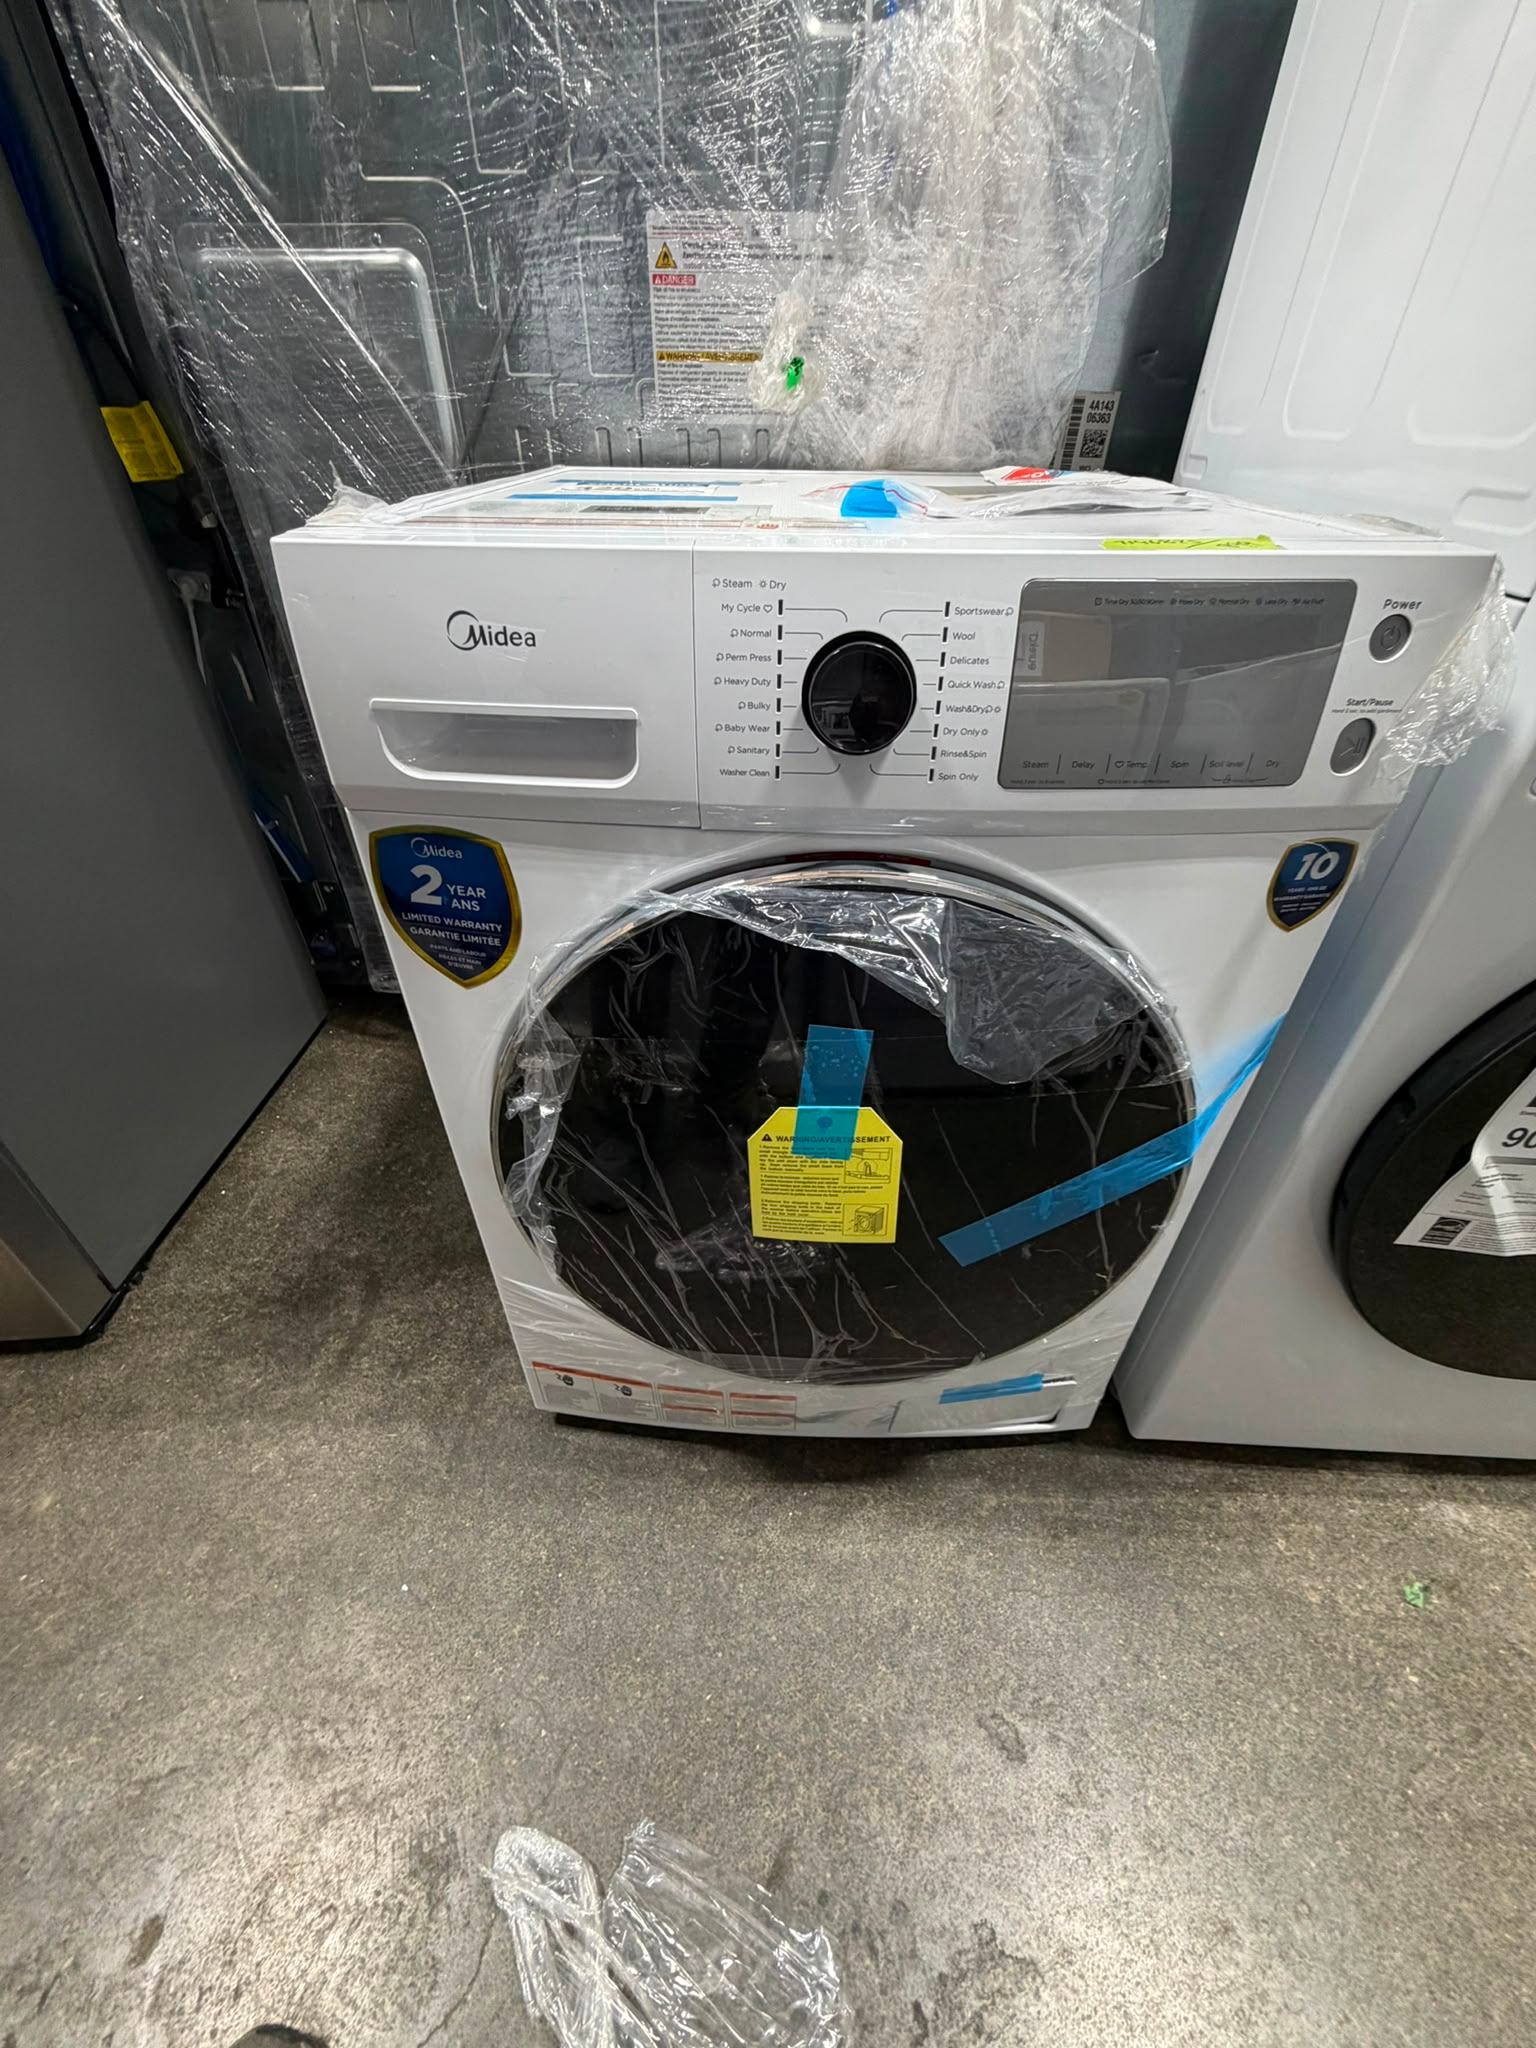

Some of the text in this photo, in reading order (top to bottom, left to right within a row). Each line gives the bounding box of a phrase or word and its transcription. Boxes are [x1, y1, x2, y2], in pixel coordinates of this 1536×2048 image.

[662, 274, 694, 286] DANGER
[1089, 400, 1115, 411] 4A143
[722, 578, 787, 591] Steam Dry
[721, 603, 761, 613] My Cycle
[1382, 599, 1423, 610] Power
[954, 606, 1005, 616] Sportswear
[450, 613, 537, 649] Midea
[740, 629, 772, 638] Normal
[952, 631, 976, 640] Wool
[725, 653, 772, 662] Perm Press
[950, 656, 990, 665] Delicates
[724, 677, 771, 687] Heavy Duty
[947, 680, 996, 689] Quick Wash
[747, 701, 771, 711] Bulky
[1346, 698, 1394, 707] Start/Pause
[945, 704, 985, 714] Wash&Dry
[724, 724, 770, 733] Baby Wear
[943, 727, 980, 737] Dry Only
[736, 746, 770, 755] Sanitary
[940, 750, 987, 758] Rinse&Spin
[1022, 760, 1049, 768] Steam
[1072, 760, 1095, 770] Delay
[1170, 760, 1189, 770] Spin
[1209, 760, 1224, 768] Soil
[1265, 760, 1280, 769] Dry
[938, 772, 979, 782] Spin Only
[412, 838, 463, 859] Midea
[1294, 852, 1340, 880] 10
[410, 864, 442, 906] 2
[446, 884, 486, 898] YEAR
[452, 898, 480, 912] ANS
[402, 912, 502, 932] LIMITED WARRANTY
[410, 926, 502, 946] GARANTIE LIMITÉE
[776, 1135, 890, 1144] WARNING/AVERTISSEMENT
